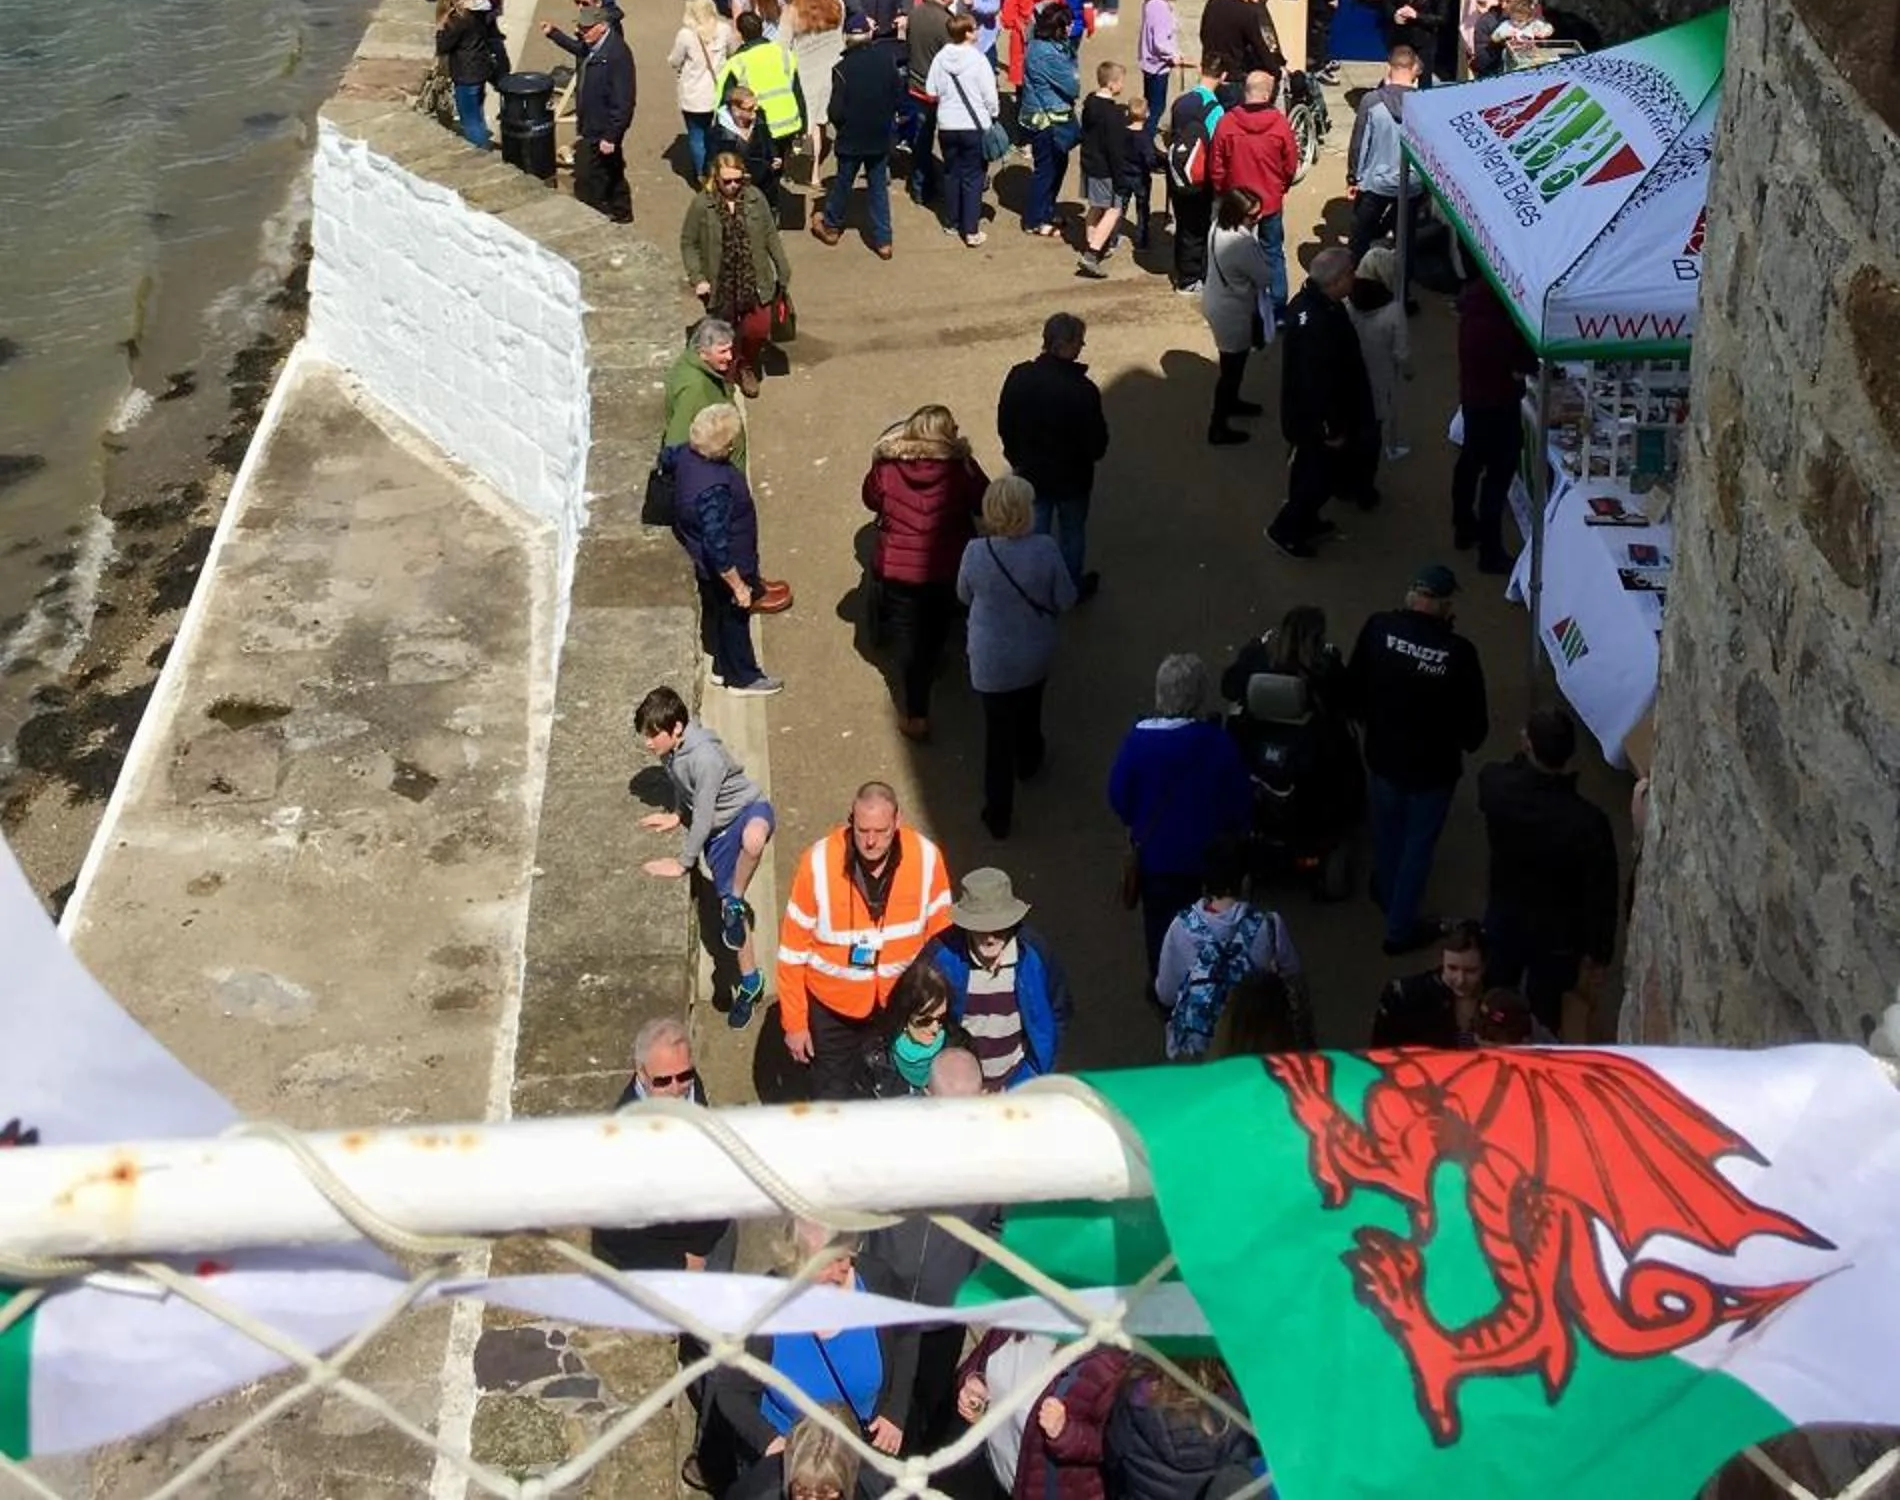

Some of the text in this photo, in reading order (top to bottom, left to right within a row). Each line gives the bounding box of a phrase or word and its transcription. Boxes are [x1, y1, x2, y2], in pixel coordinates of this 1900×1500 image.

[1475, 142, 1522, 189] Menai
[1503, 182, 1542, 228] Bikes
[1387, 634, 1449, 663] FENDT
